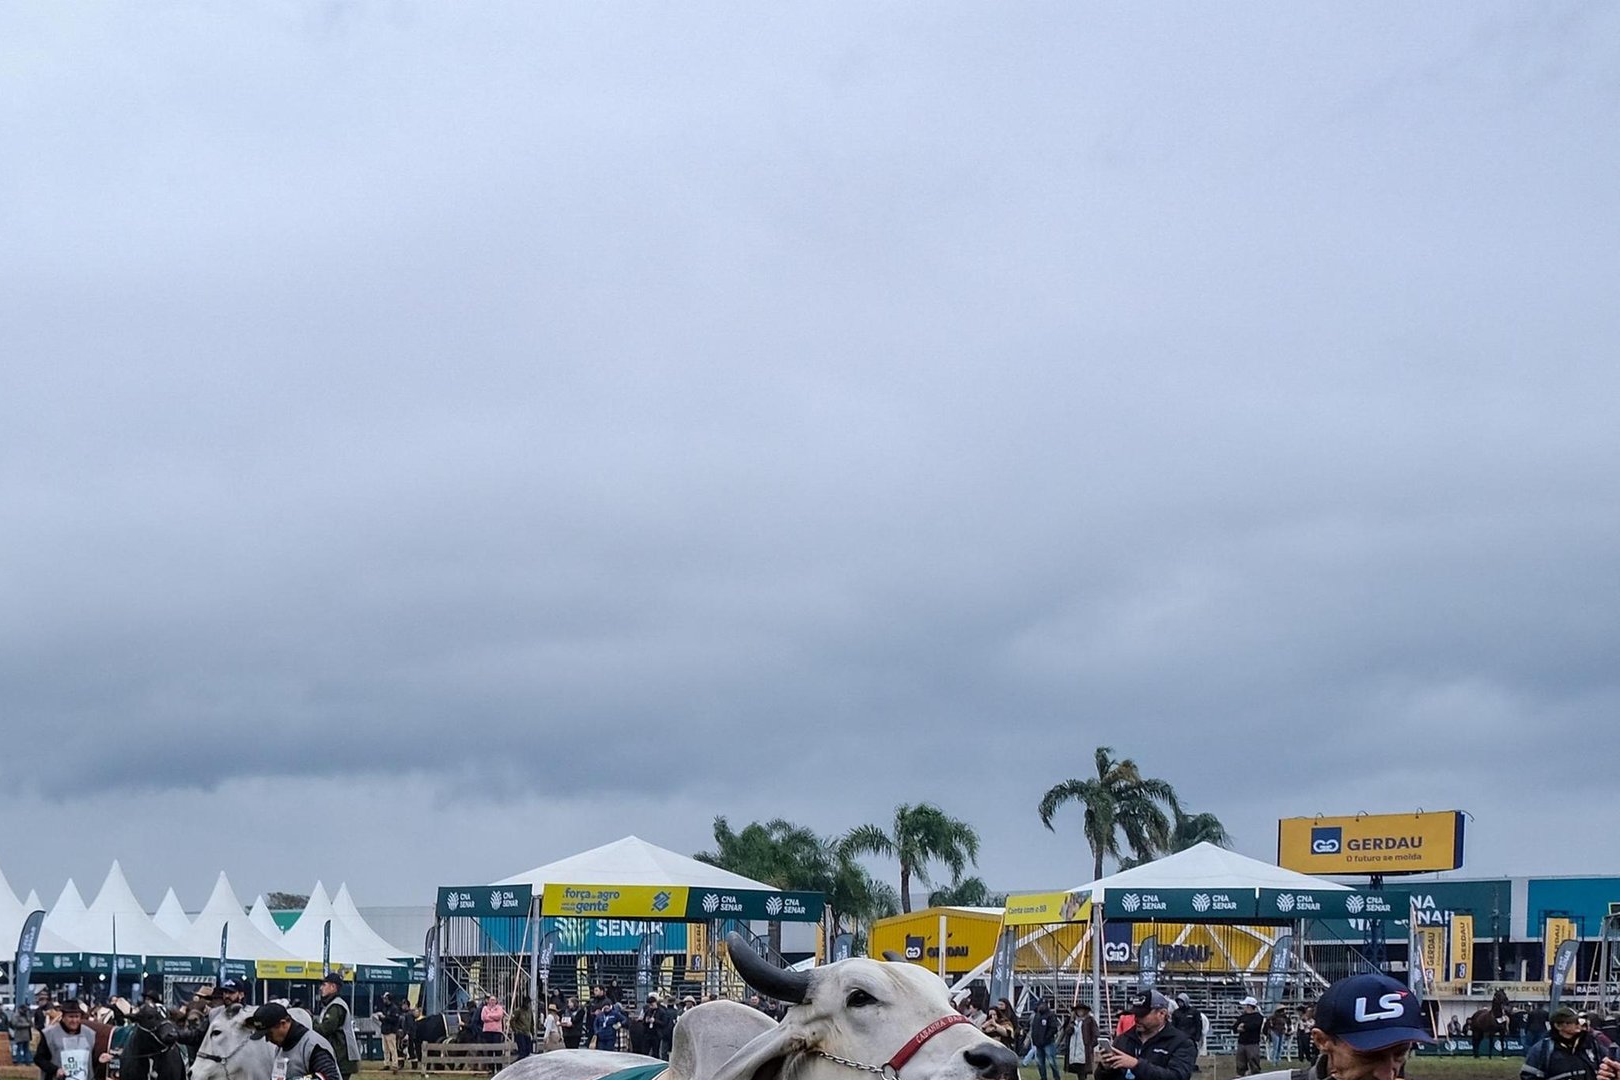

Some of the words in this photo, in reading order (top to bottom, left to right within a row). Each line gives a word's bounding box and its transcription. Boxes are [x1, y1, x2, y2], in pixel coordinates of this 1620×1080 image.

[1347, 836, 1423, 851] GERDAU
[565, 887, 591, 900] força
[598, 891, 620, 901] agro
[1366, 896, 1383, 904] CNA
[576, 901, 609, 914] gente
[720, 904, 743, 912] SENAR
[784, 898, 800, 906] CNA
[1366, 904, 1391, 912] SENAR
[1410, 895, 1435, 909] NA
[783, 906, 806, 914] SENAR
[596, 919, 664, 937] SENAR
[927, 946, 968, 958] GEDAU
[1427, 932, 1435, 966] GERDAU
[1355, 993, 1404, 1022] LS
